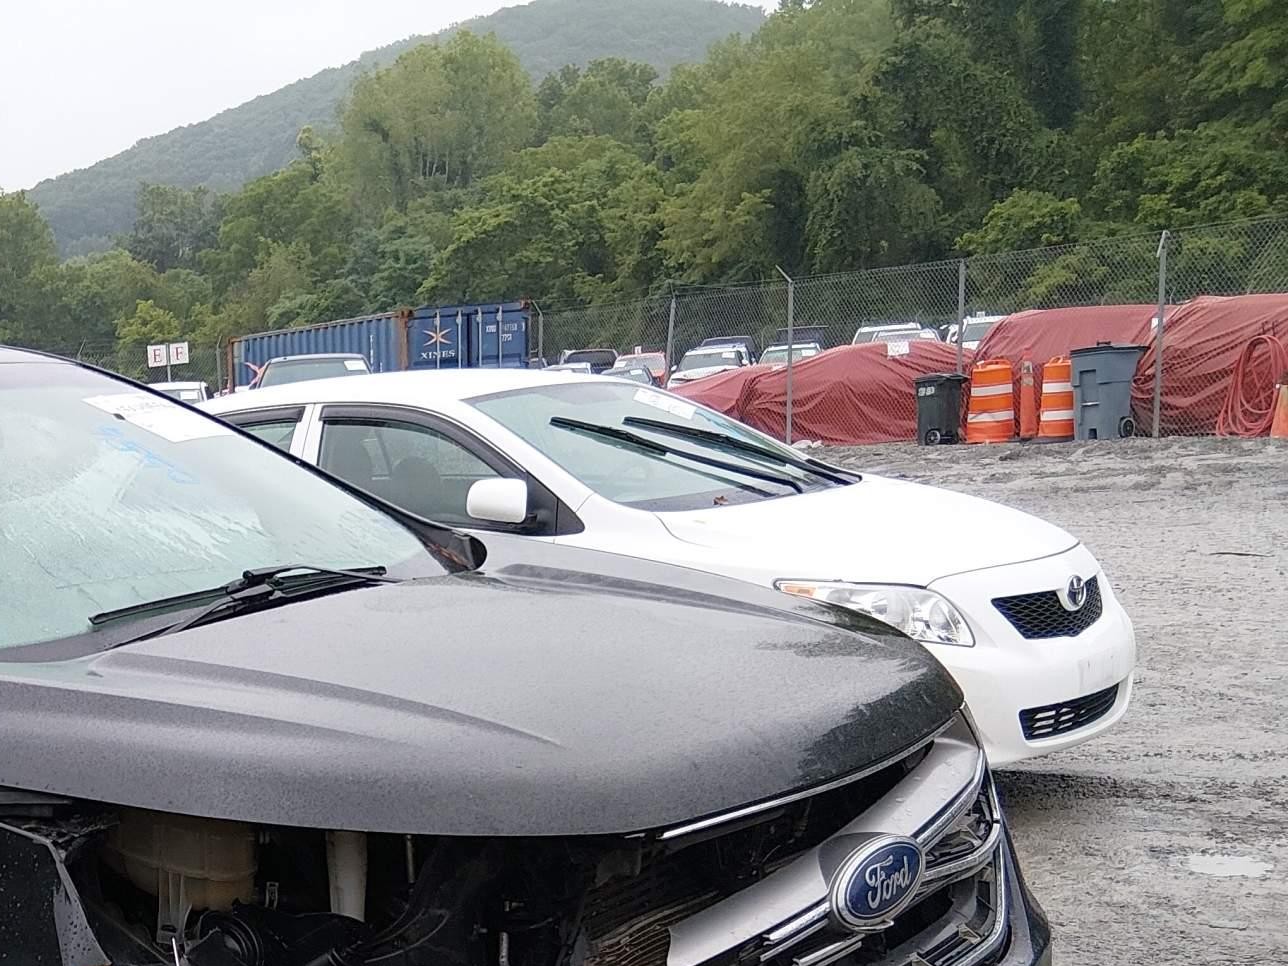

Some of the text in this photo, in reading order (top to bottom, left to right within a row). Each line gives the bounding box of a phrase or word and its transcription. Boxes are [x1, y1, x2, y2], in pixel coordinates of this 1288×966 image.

[153, 348, 162, 363] E
[175, 346, 184, 361] F
[865, 854, 912, 909] Ford
